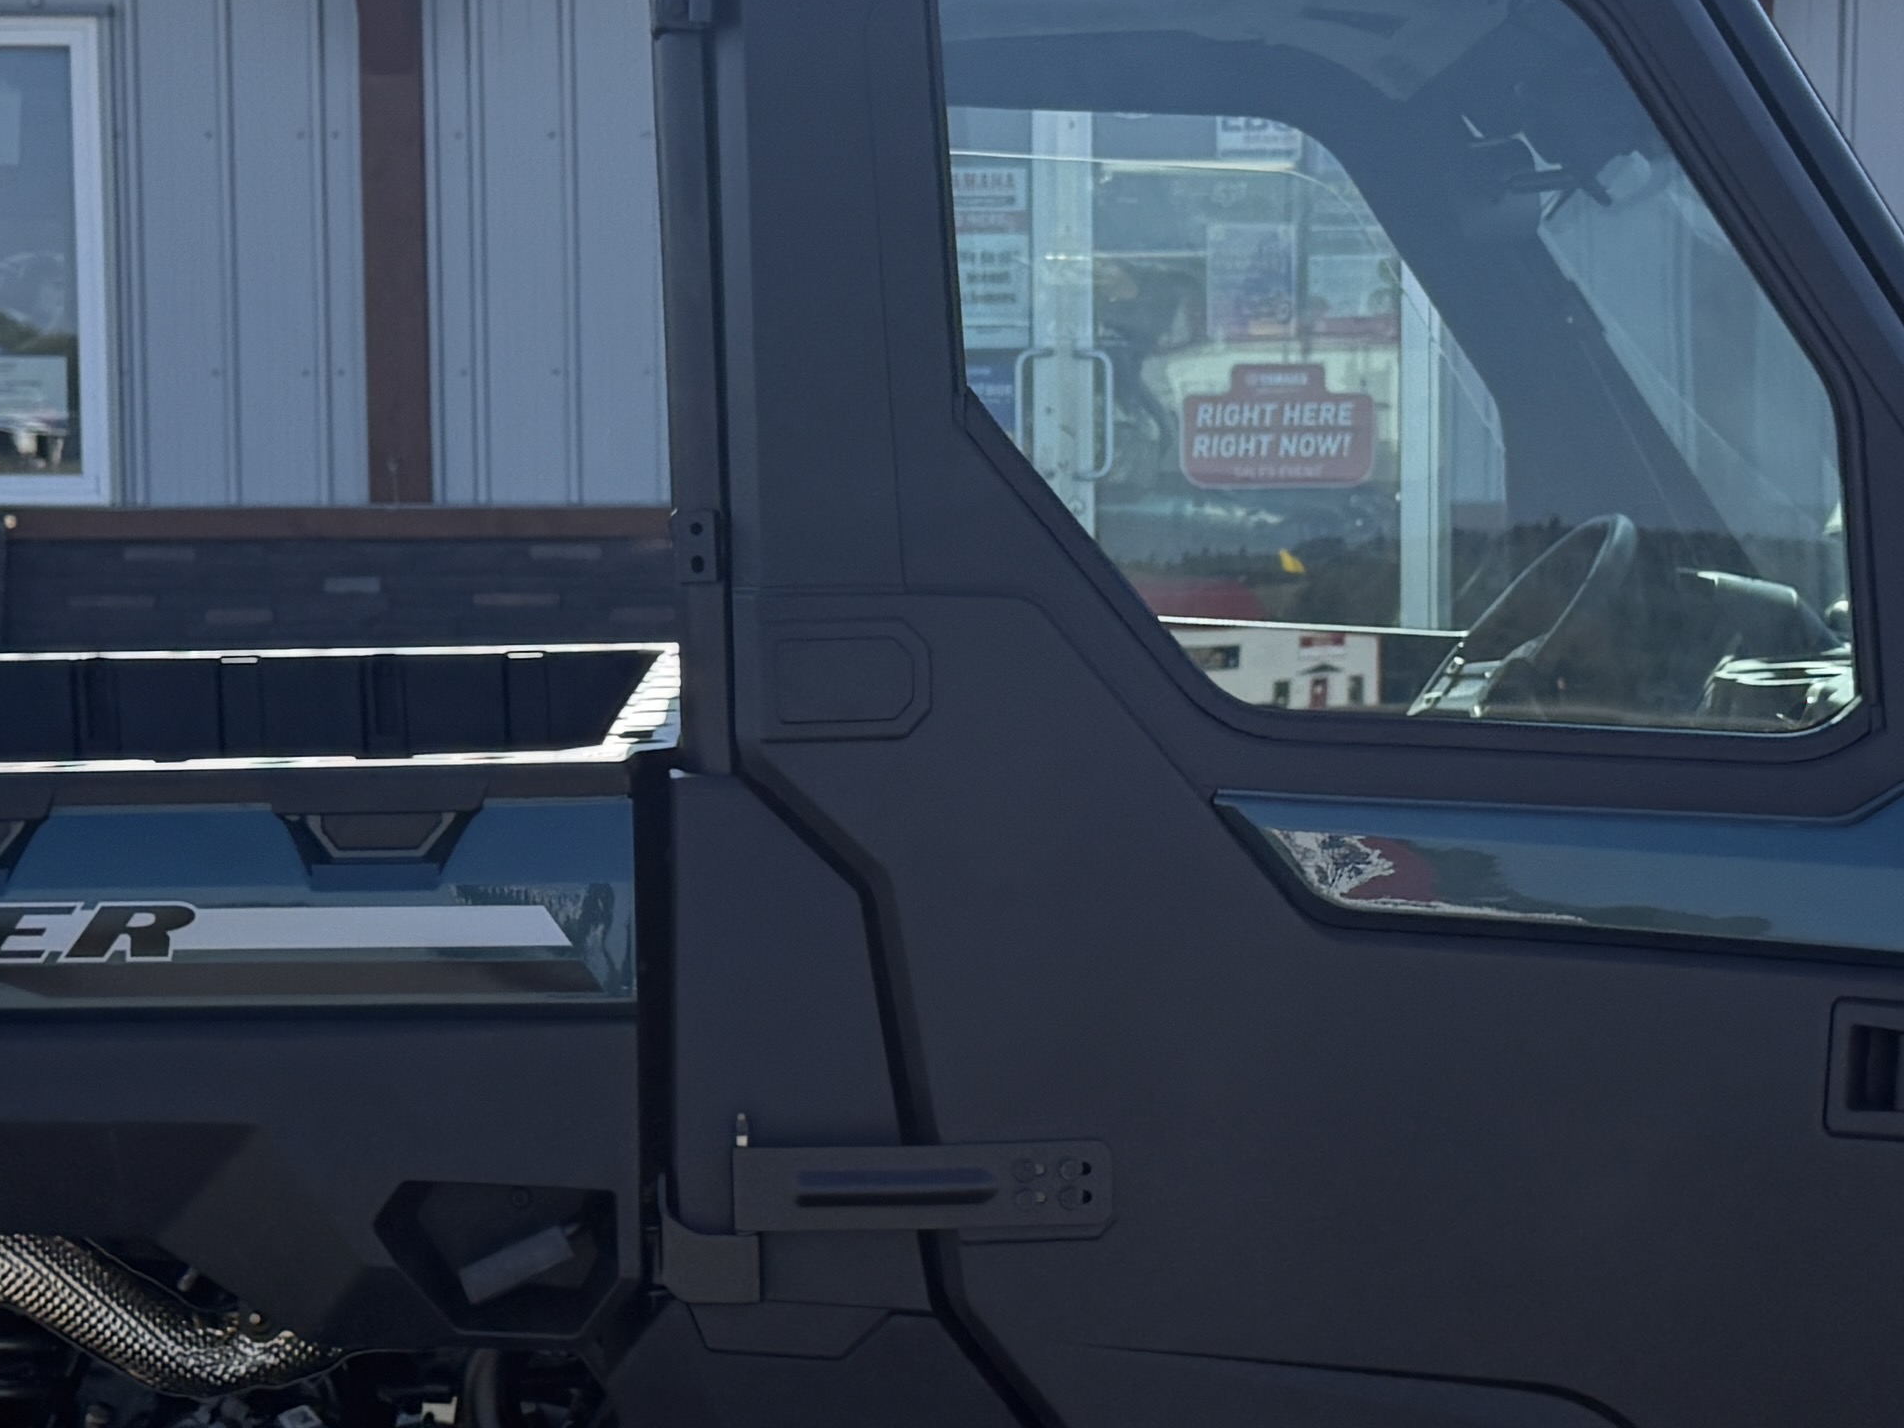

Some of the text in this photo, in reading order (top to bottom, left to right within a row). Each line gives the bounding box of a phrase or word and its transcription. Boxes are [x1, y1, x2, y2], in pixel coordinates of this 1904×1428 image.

[1197, 400, 1355, 427] RIGHT HERE
[1192, 432, 1354, 458] RIGHT NOW!
